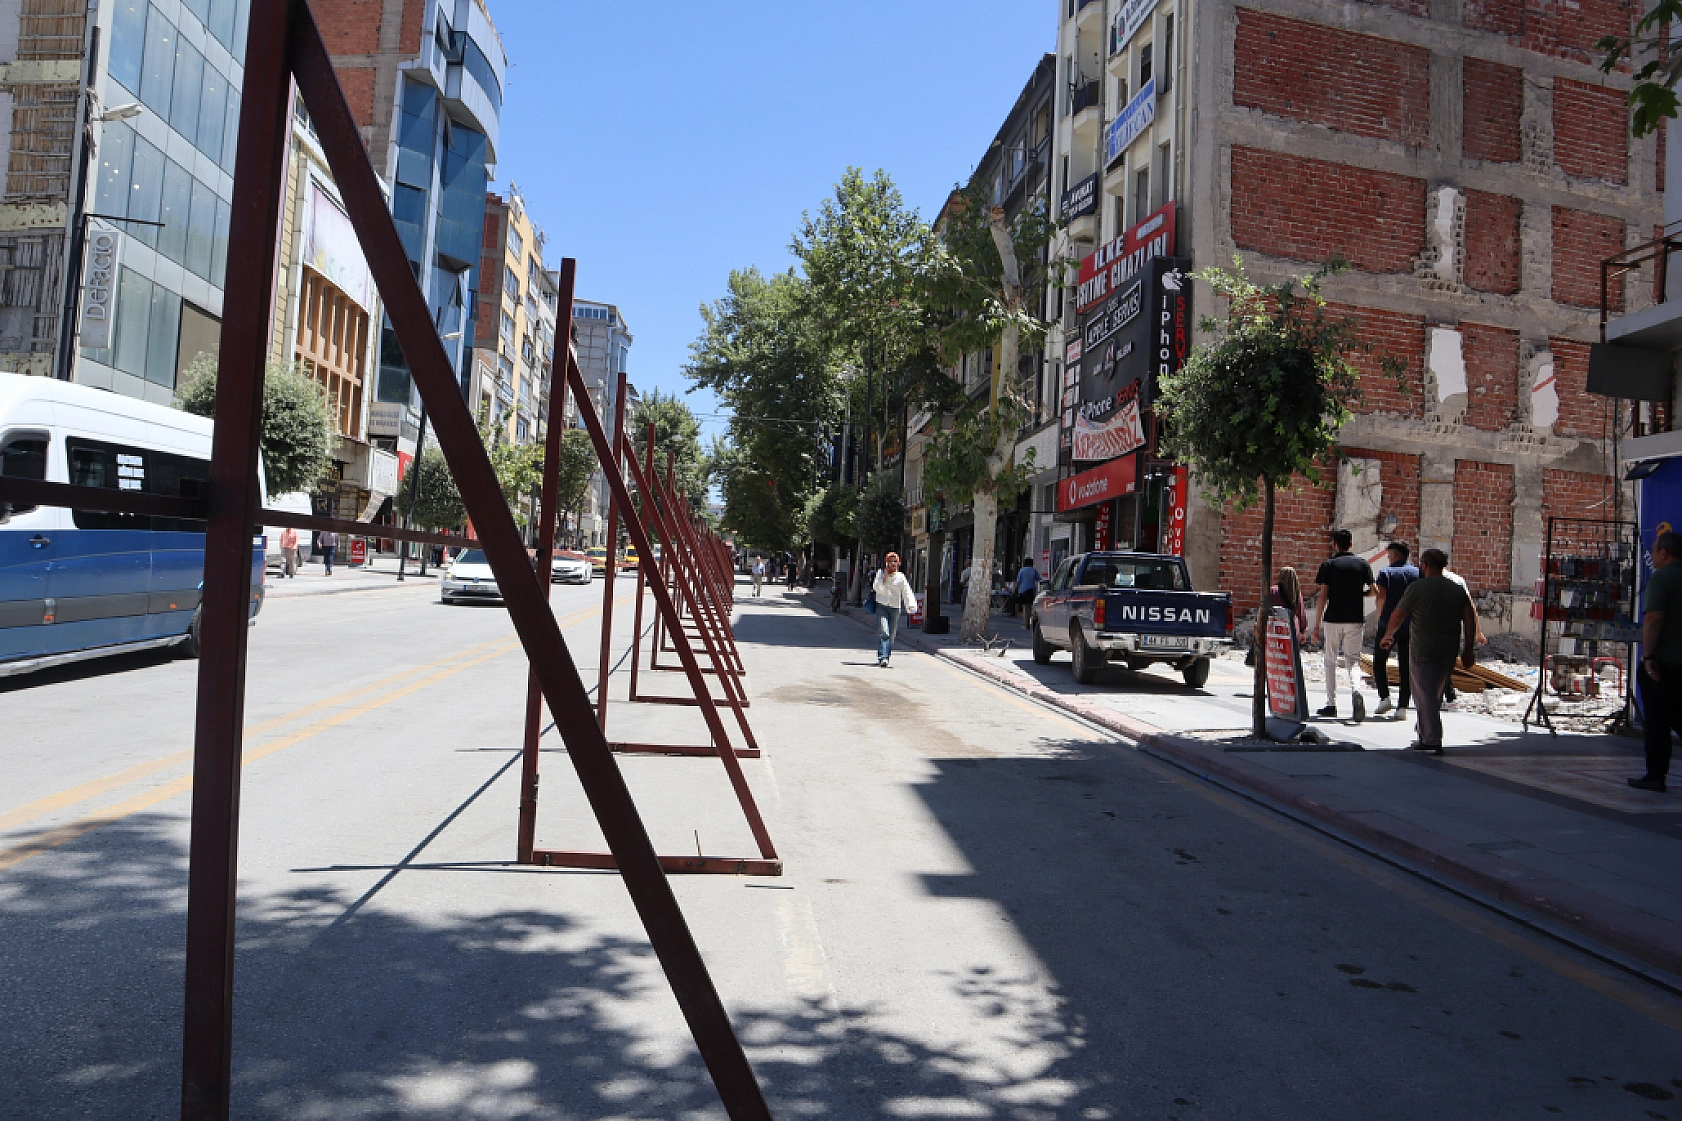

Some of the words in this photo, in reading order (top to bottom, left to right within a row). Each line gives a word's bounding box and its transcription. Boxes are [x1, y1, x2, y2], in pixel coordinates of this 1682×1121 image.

[86, 233, 114, 321] DeFacto
[1078, 477, 1108, 500] vodafone
[1122, 605, 1211, 624] NISSAN
